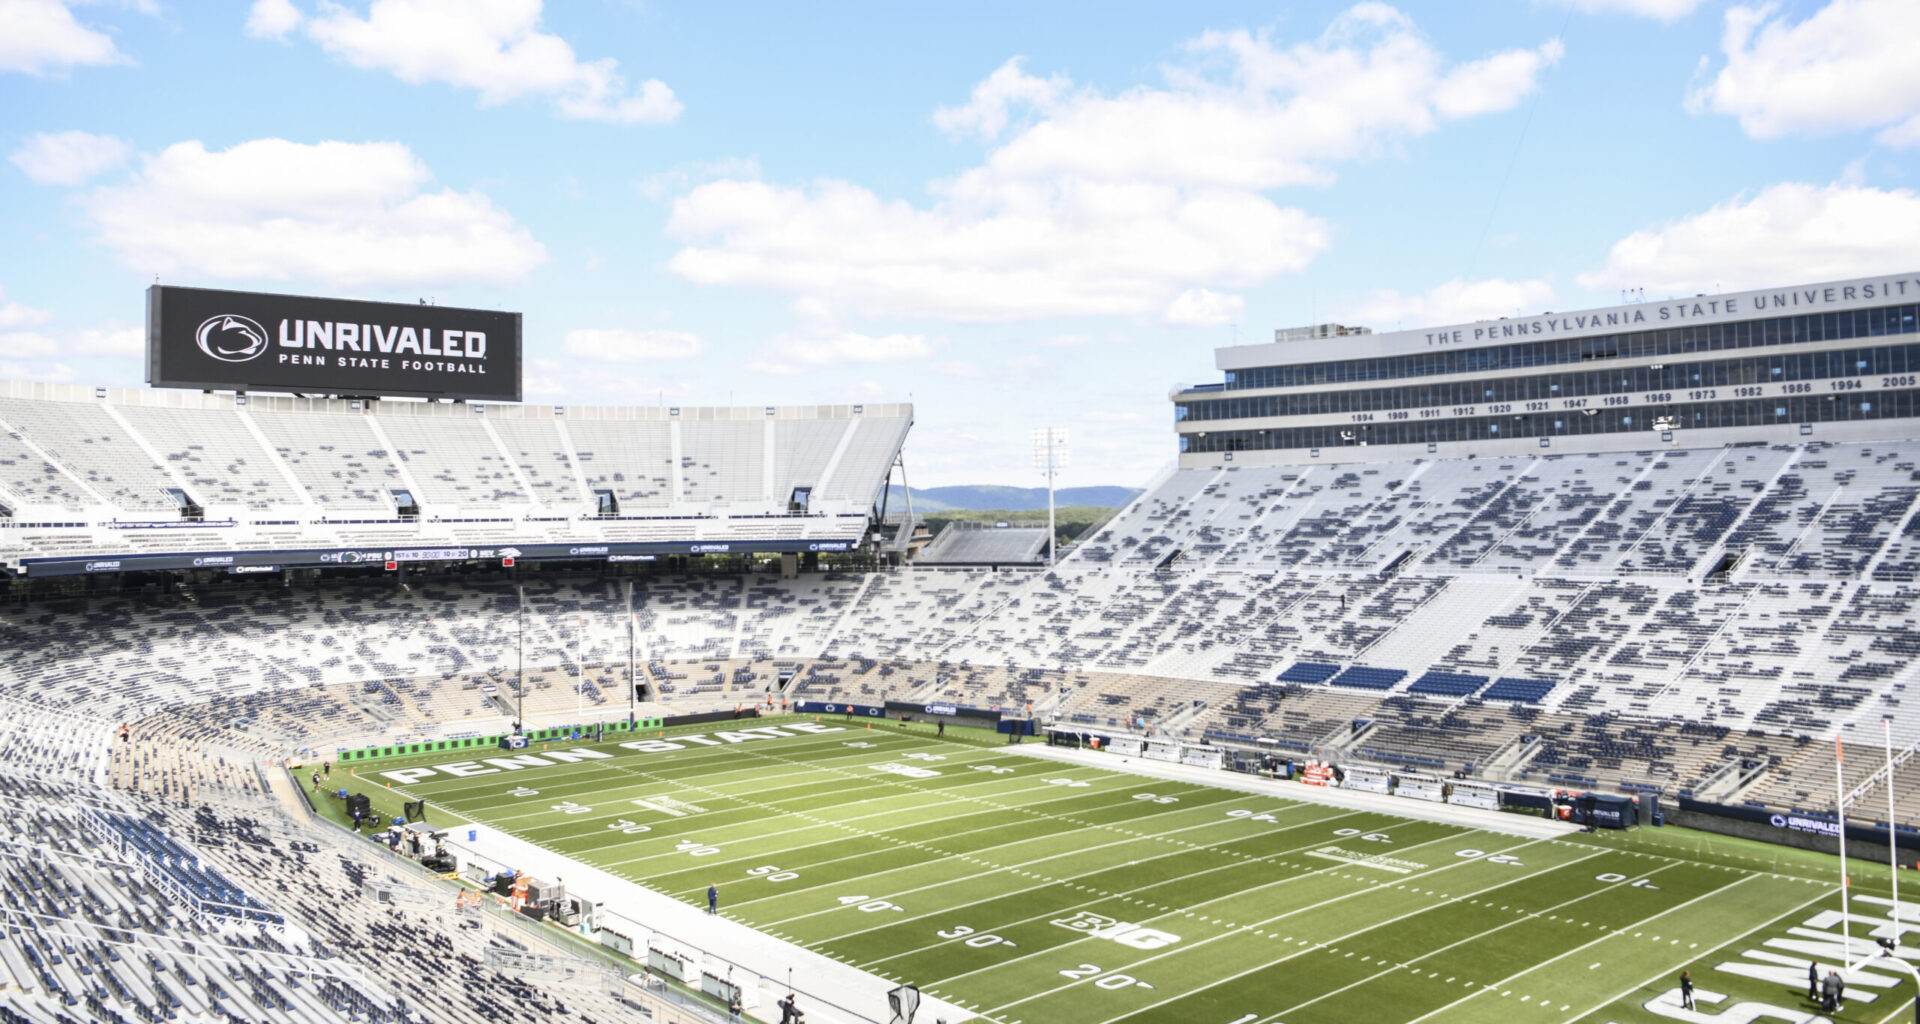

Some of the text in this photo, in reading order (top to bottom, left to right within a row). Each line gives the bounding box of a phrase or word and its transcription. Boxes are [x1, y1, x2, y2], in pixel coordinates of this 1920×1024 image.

[1425, 330, 1462, 346] THE
[1474, 310, 1646, 340] PENNSYLVANIA
[1659, 299, 1738, 320] STATE
[279, 318, 486, 358] UNRIVALED
[280, 354, 486, 374] PENN STATE FOOTBALL
[1351, 376, 1916, 422] 1894 1909 1911 1912 1920 1921 1947 1968 1969 1973 1982 1986 1994 2005
[380, 722, 846, 784] PENN STATE
[553, 801, 592, 814] 20
[609, 819, 652, 834] 30
[1332, 828, 1390, 844] 30
[675, 840, 720, 857] 40
[1454, 848, 1518, 865] 20
[746, 865, 800, 882] 50
[1595, 872, 1655, 889] 10
[838, 895, 894, 912] 40
[937, 926, 1004, 948] 30
[1059, 964, 1138, 990] 20
